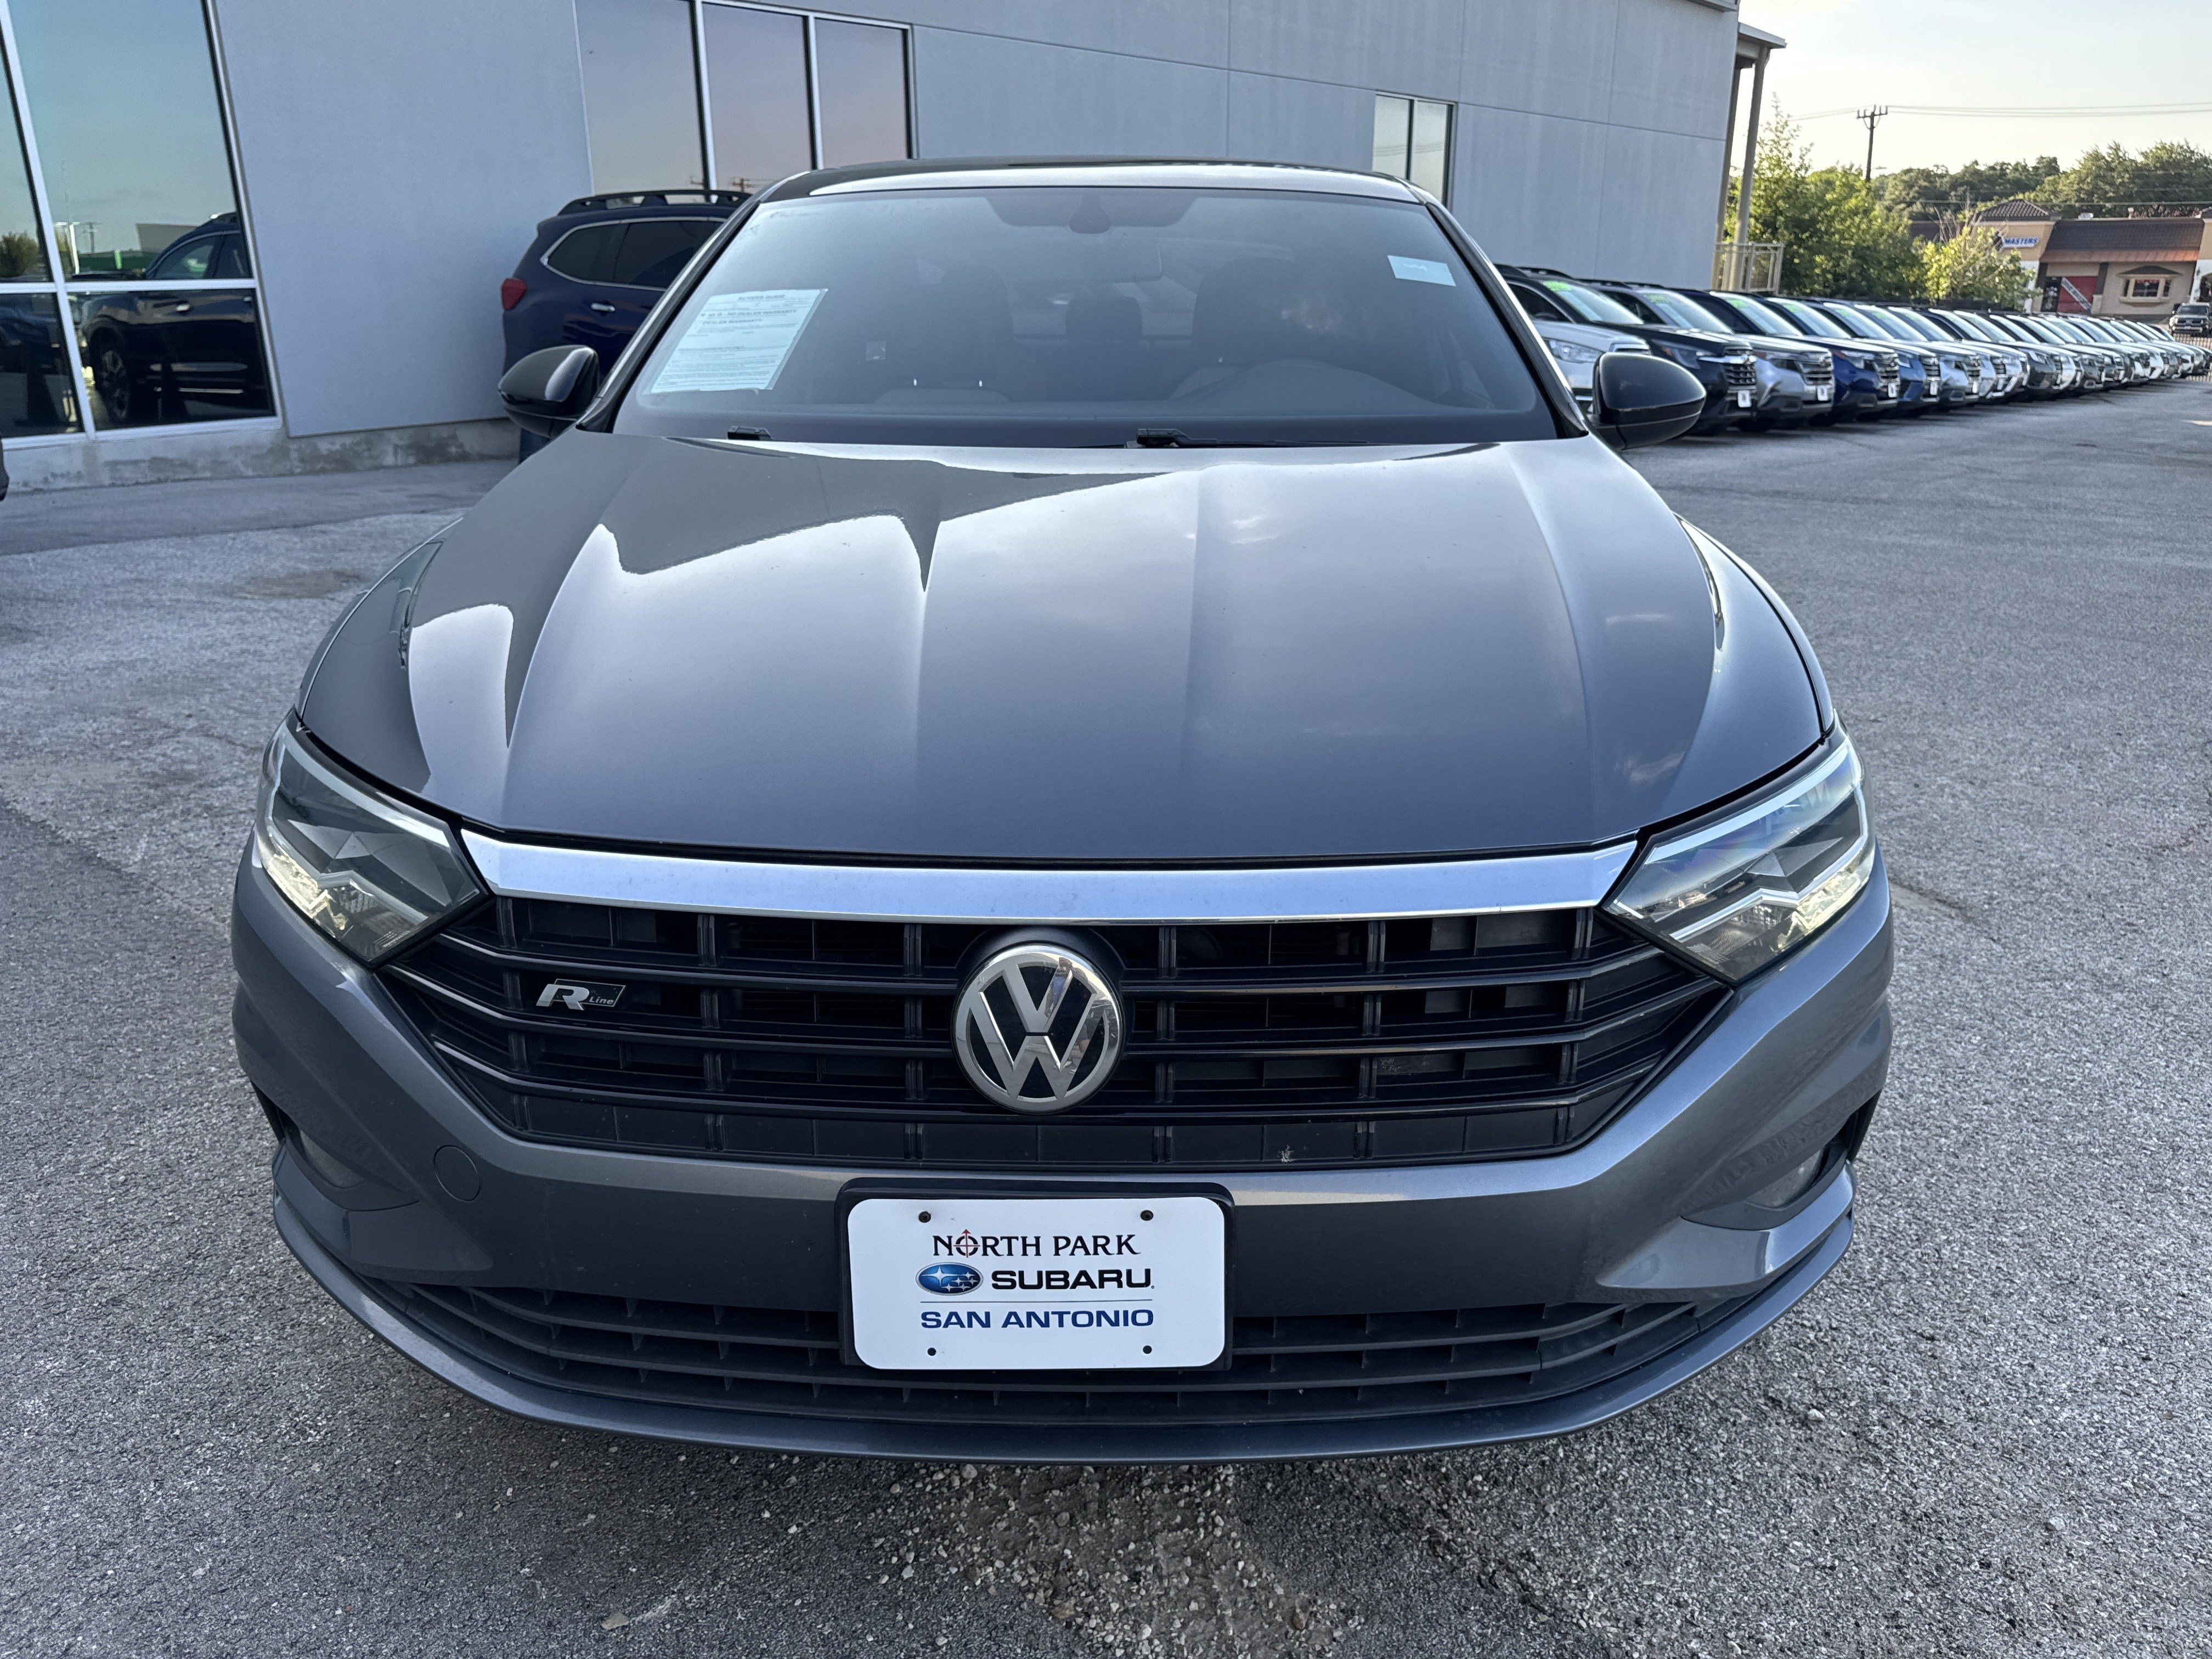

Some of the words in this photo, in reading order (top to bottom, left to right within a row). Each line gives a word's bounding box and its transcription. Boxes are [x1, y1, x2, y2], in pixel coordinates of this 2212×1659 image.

[536, 984, 590, 1011] R
[589, 996, 614, 1005] Line
[933, 1232, 1041, 1257] NORTH
[1053, 1234, 1141, 1256] PARK
[991, 1268, 1152, 1290] SUBARU
[921, 1311, 991, 1329] SAN
[1001, 1309, 1154, 1328] ANTONIO
